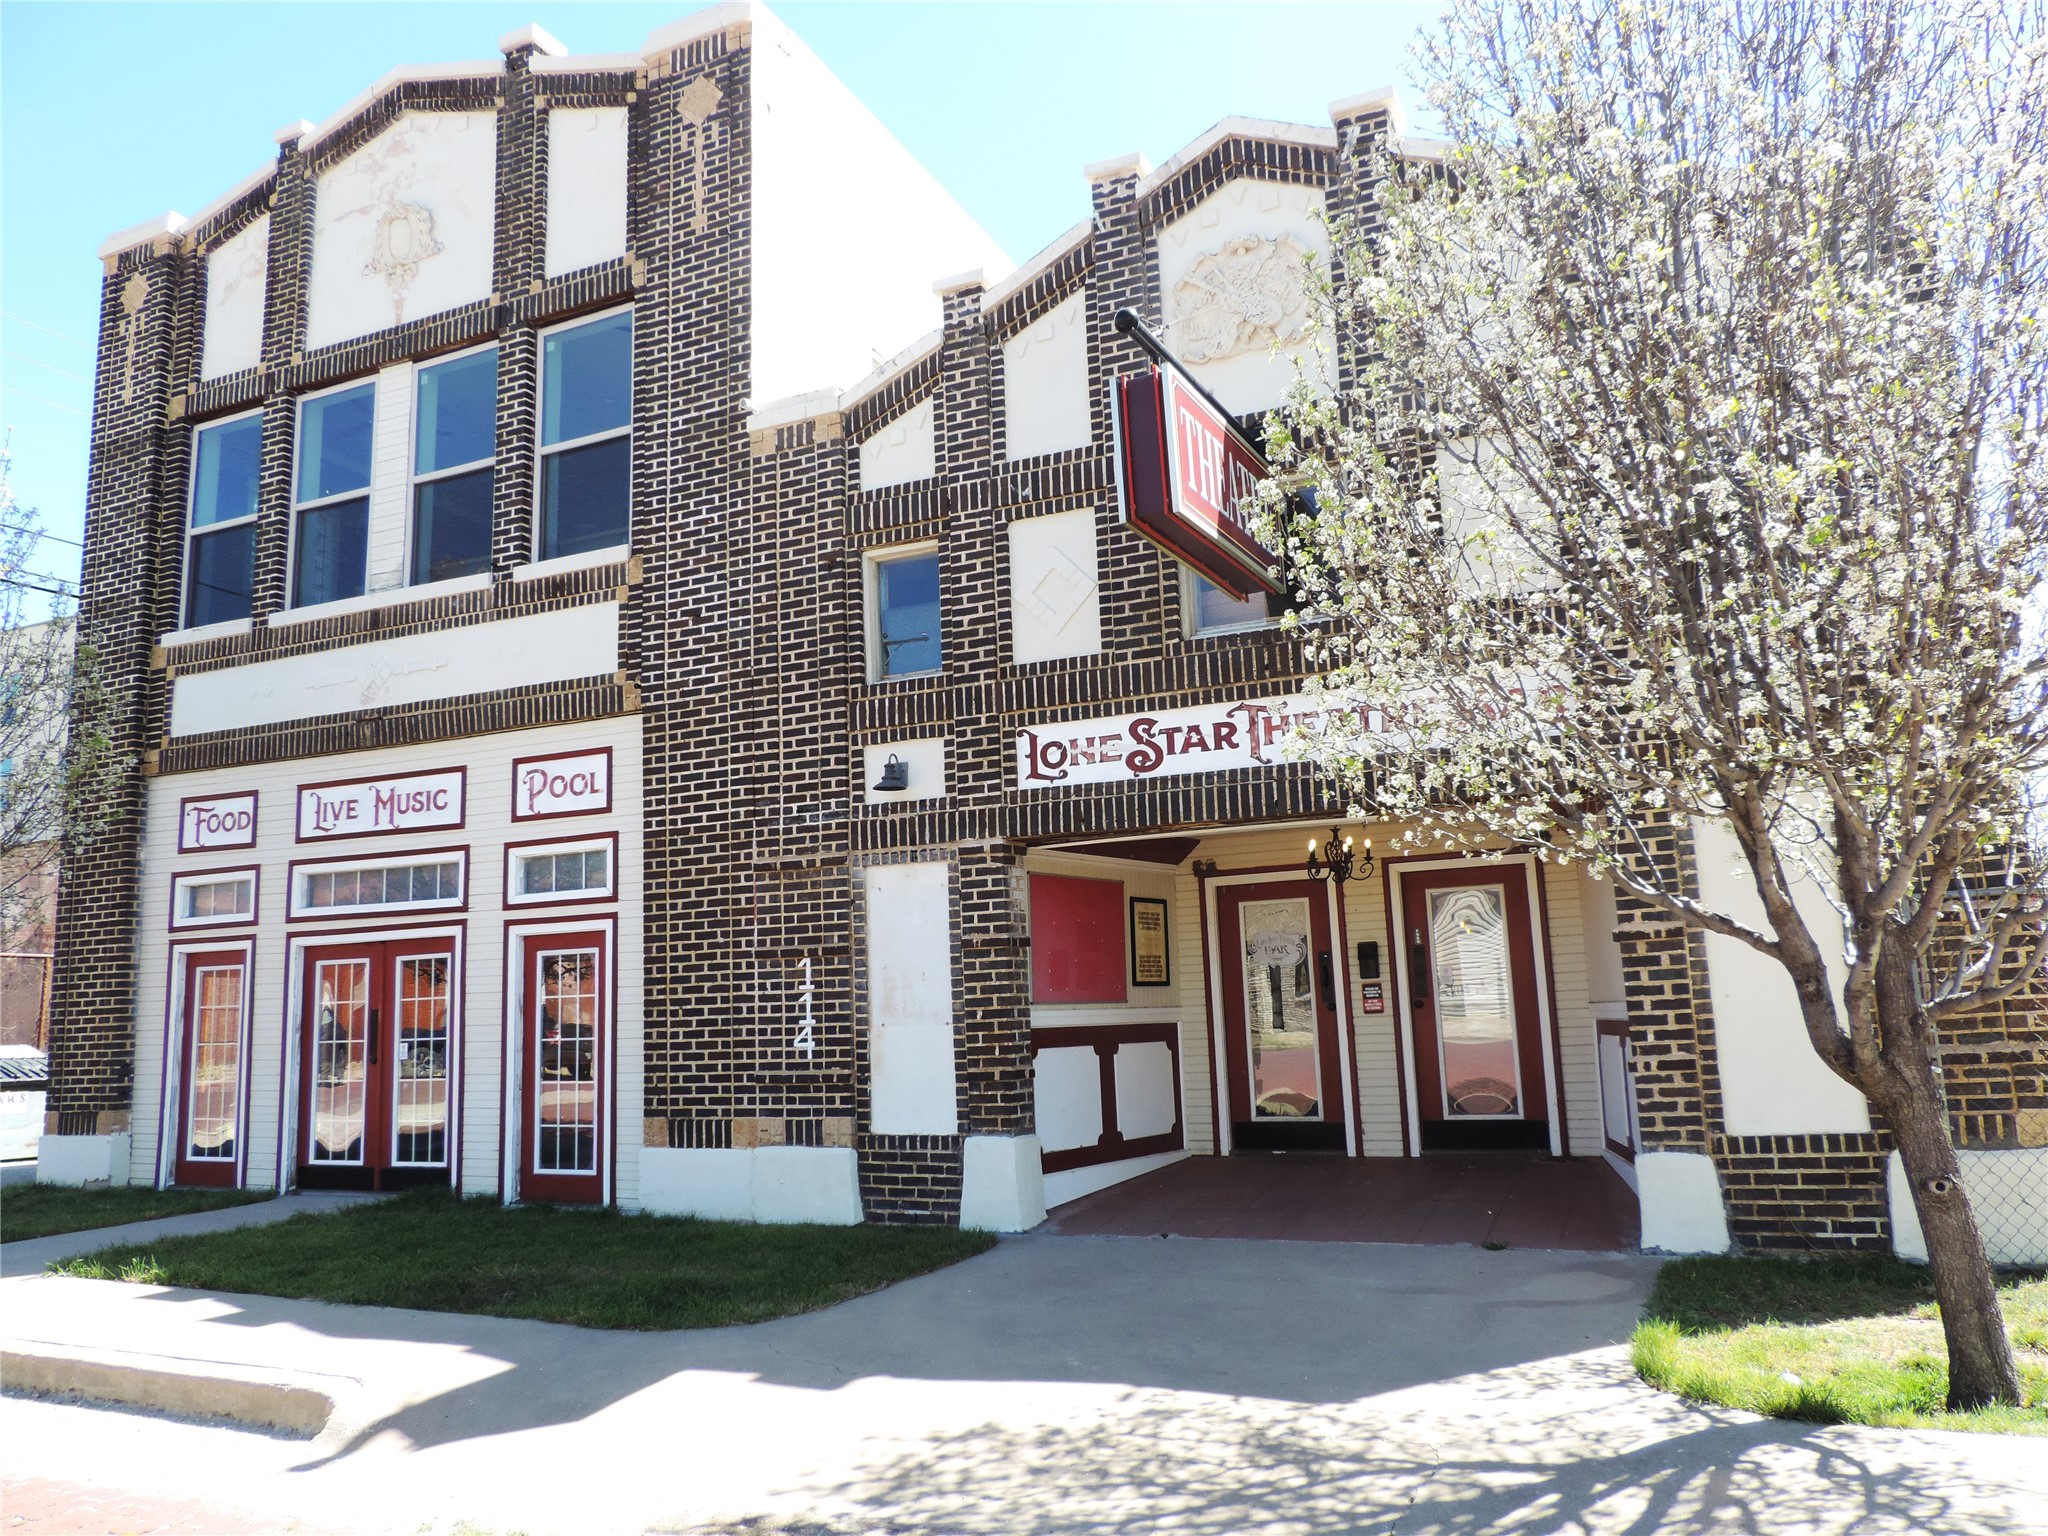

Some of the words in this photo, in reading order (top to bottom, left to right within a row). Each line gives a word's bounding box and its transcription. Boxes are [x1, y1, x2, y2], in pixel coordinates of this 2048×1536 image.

[1180, 405, 1274, 556] THEATR
[1016, 728, 1123, 784] LONE
[1125, 717, 1239, 777] STAR
[1226, 700, 1436, 765] THETR
[310, 792, 359, 833] LIVE
[369, 786, 449, 829] MUSIC
[523, 768, 602, 815] POOL
[187, 806, 251, 847] FOOD
[793, 957, 816, 1060] 114
